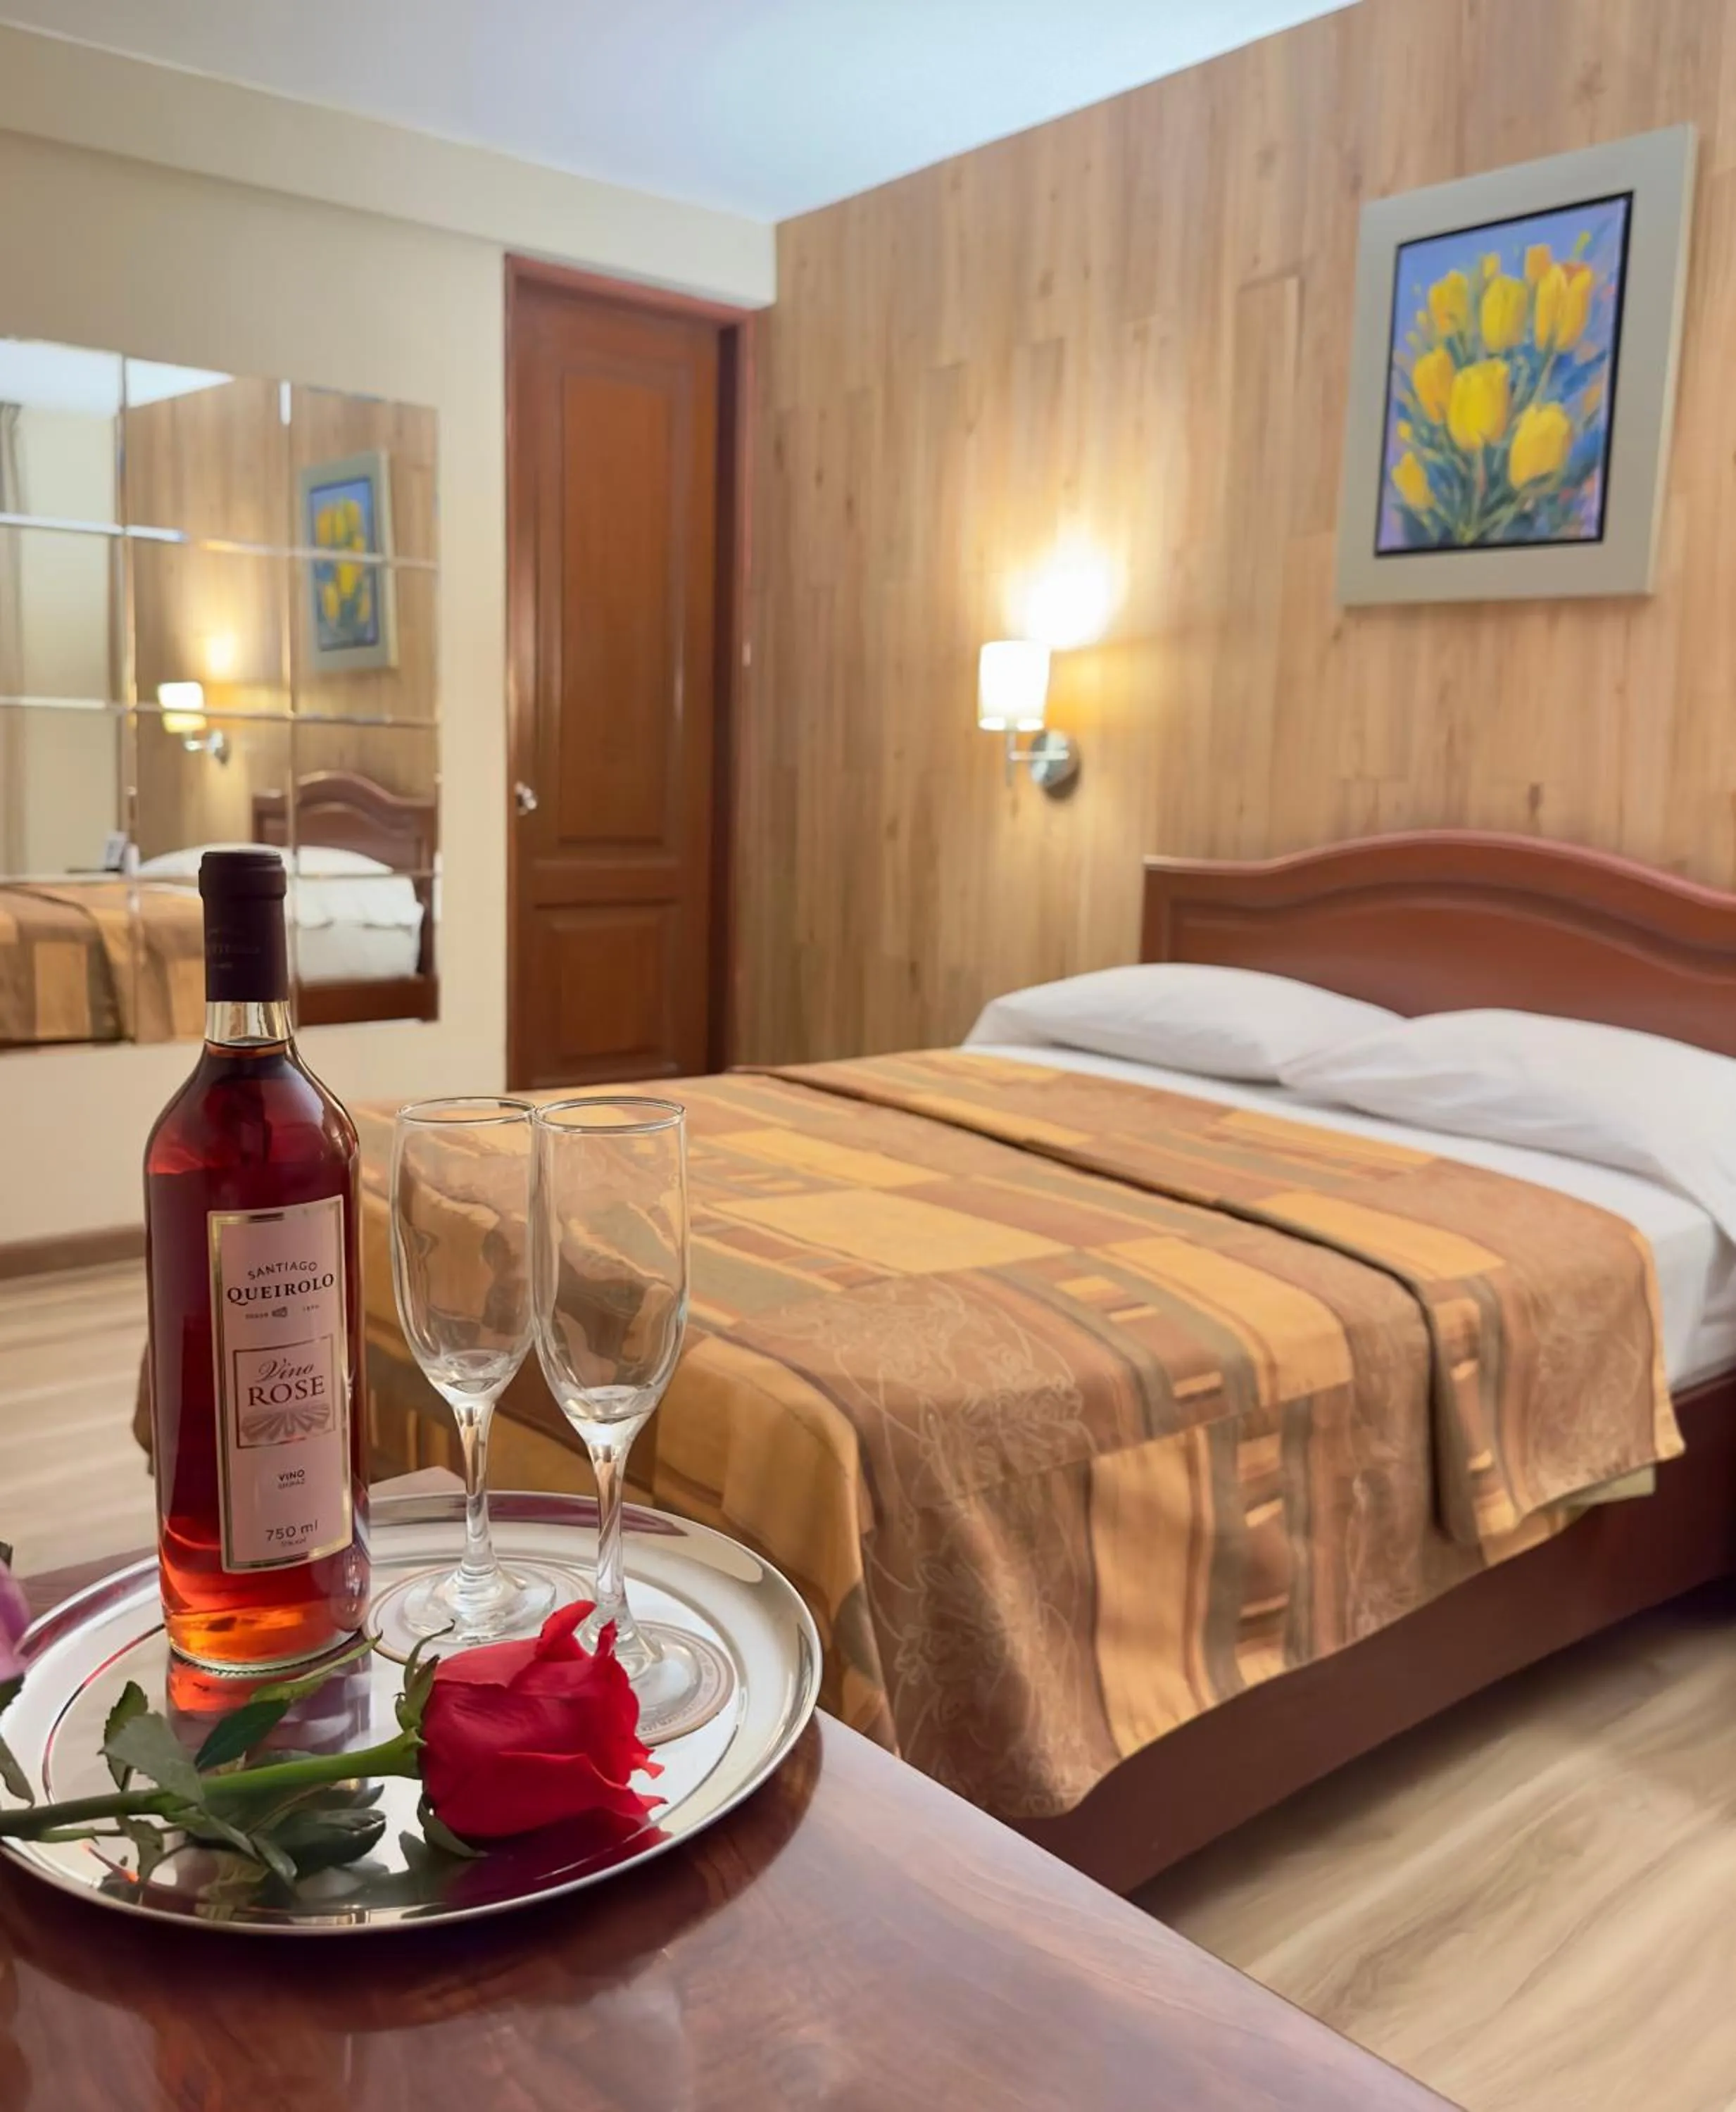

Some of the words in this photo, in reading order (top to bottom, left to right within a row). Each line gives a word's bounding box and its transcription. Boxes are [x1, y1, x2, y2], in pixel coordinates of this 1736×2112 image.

[248, 1261, 318, 1281] SANTIAGO
[227, 1273, 334, 1306] QUEIROLO
[256, 1357, 315, 1383] Vino
[248, 1375, 325, 1407] ROSE
[278, 1469, 306, 1482] VINO
[265, 1526, 296, 1542] 750
[301, 1519, 318, 1534] ml
